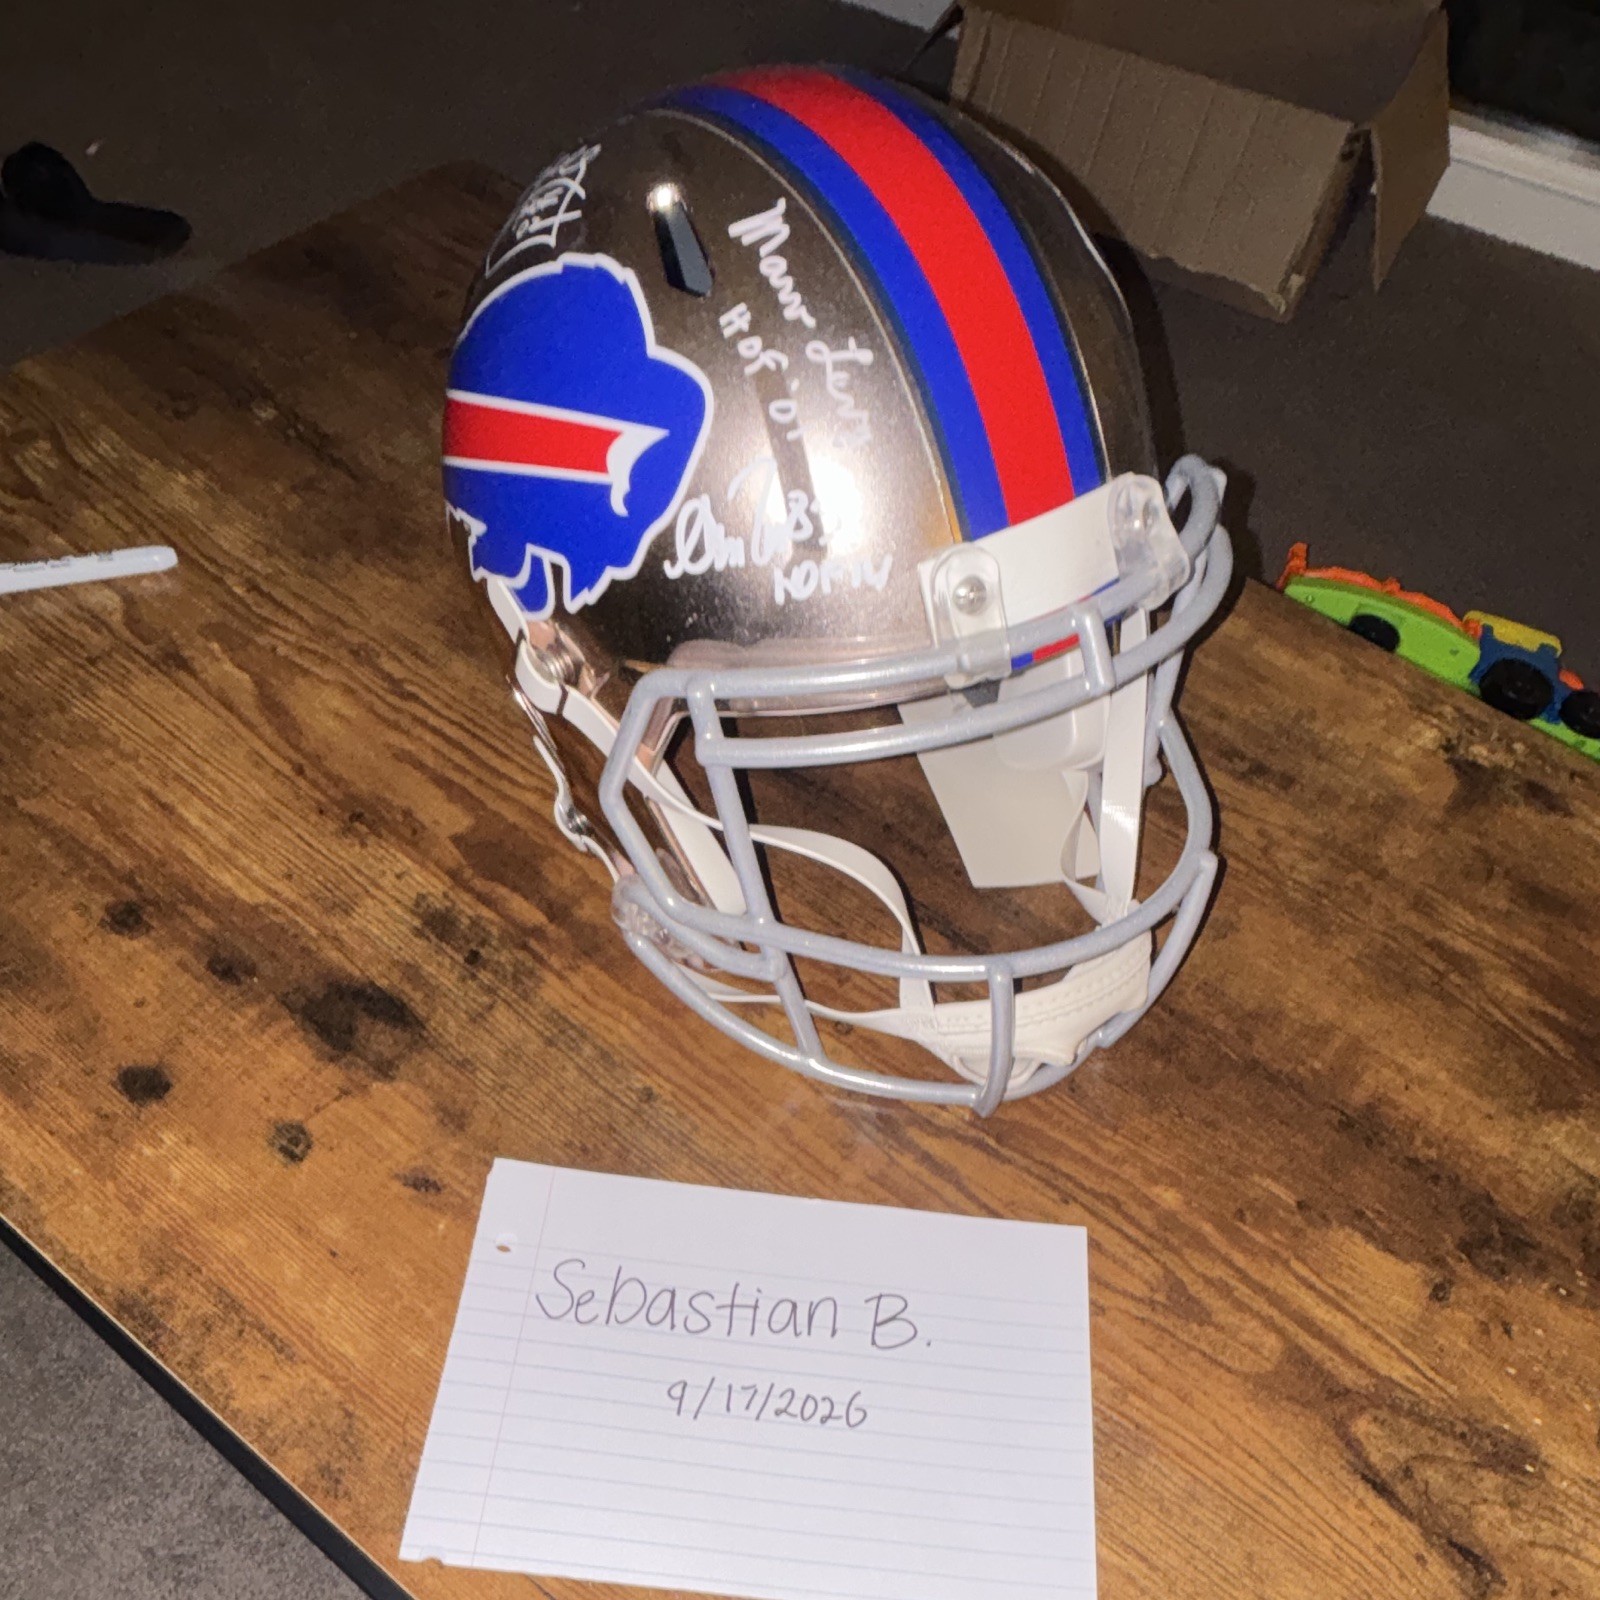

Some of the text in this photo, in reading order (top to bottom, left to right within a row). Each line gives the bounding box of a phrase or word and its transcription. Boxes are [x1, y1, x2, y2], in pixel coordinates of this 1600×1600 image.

[718, 301, 790, 376] HOF
[535, 1257, 932, 1350] Sebastian B.
[666, 1376, 868, 1429] 9/17/2026
